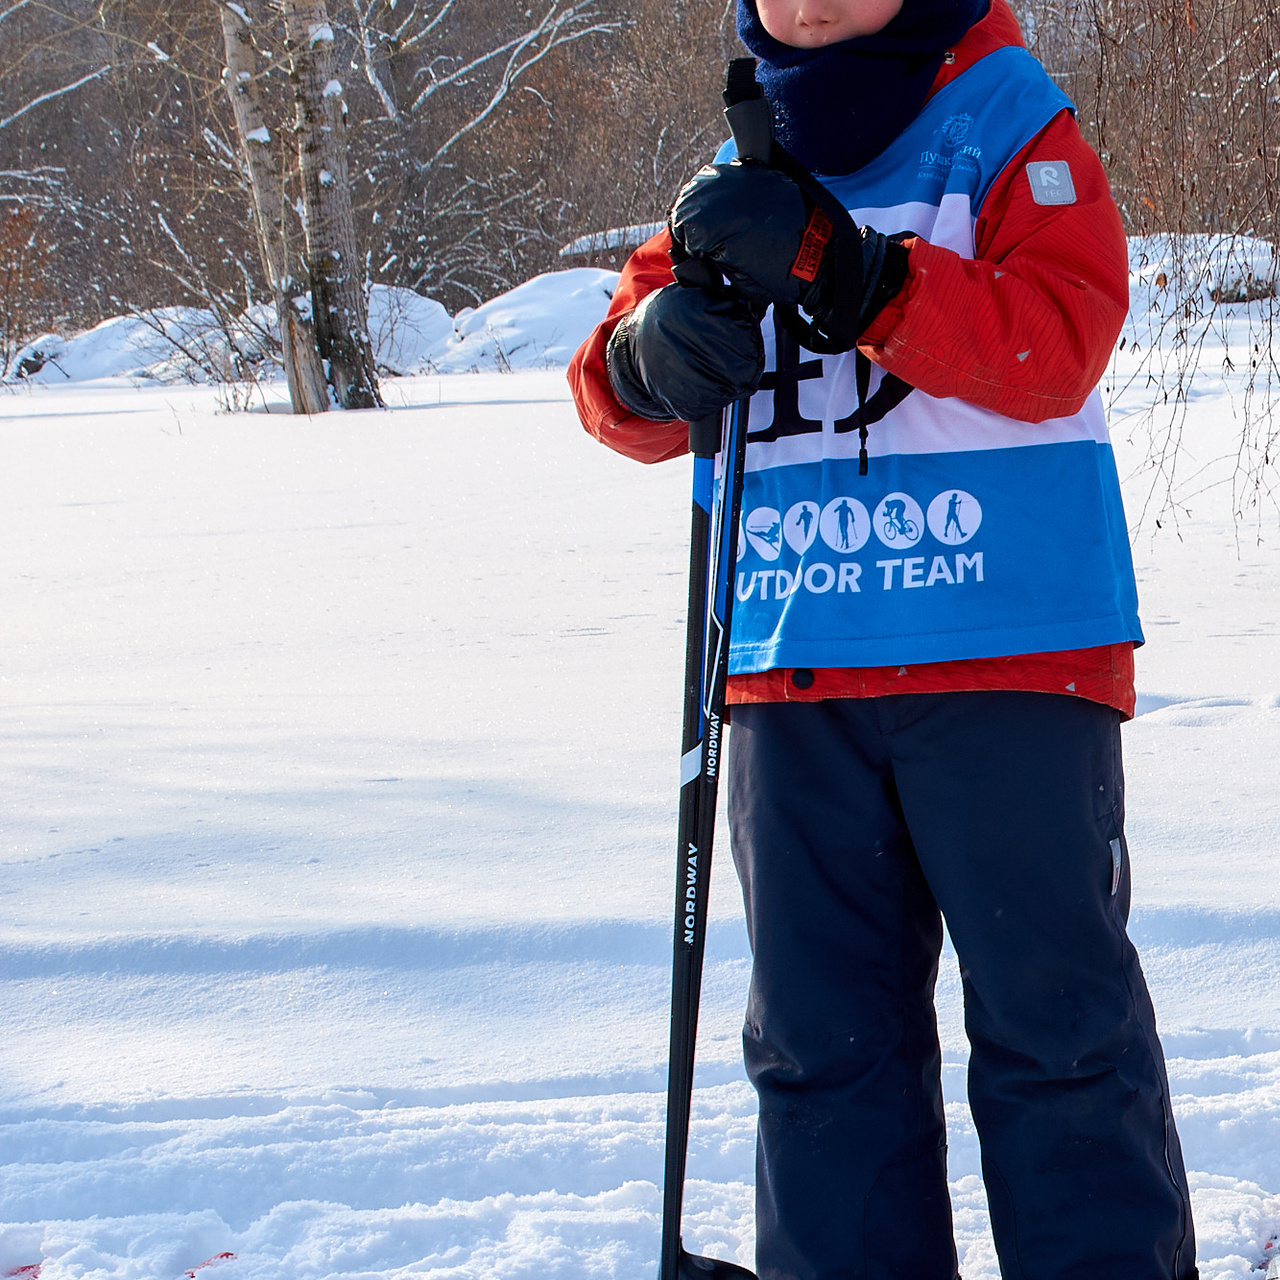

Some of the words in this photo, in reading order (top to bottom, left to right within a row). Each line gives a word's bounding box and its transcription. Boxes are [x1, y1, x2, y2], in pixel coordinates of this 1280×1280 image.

[920, 144, 982, 166] Пушкий
[875, 552, 985, 590] TEAM
[706, 711, 721, 777] NORDWAY
[683, 841, 700, 945] NORDWAY
